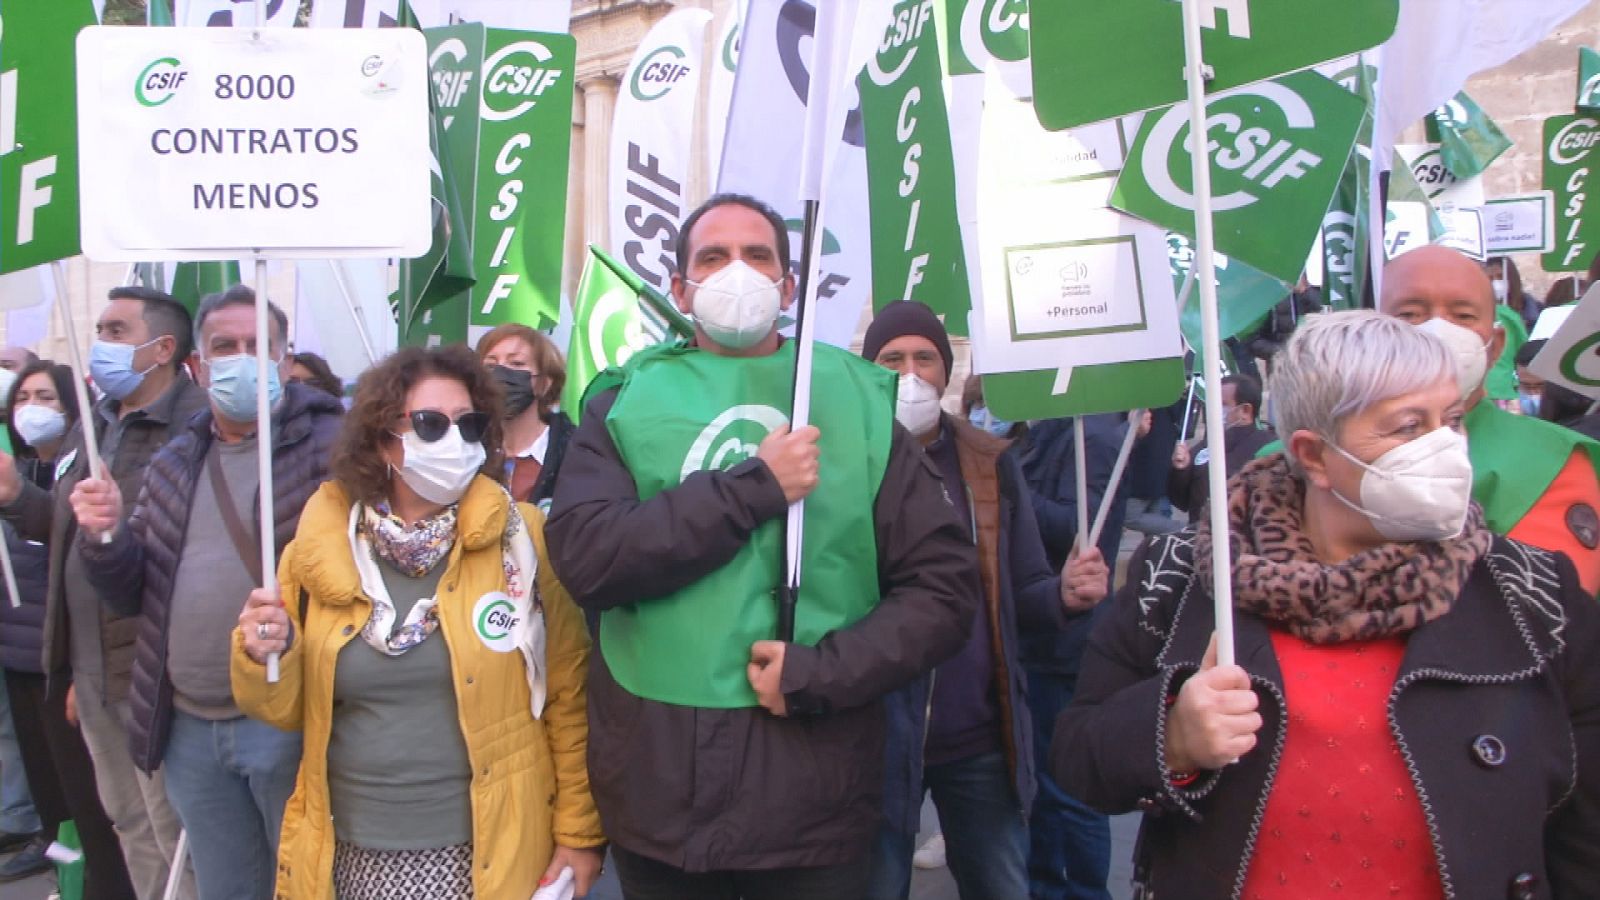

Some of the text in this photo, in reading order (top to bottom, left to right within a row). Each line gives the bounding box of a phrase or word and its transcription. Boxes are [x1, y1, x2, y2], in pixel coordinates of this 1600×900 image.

[146, 71, 189, 91] CSIF
[488, 64, 562, 96] CSIF
[642, 62, 691, 84] CSIF
[215, 74, 296, 100] 8000
[151, 127, 359, 155] CONTRATOS
[1183, 112, 1323, 190] CSIF
[193, 182, 320, 210] MENOS
[480, 133, 532, 315] CSIF
[1046, 301, 1108, 318] +Personal
[488, 610, 520, 630] CSIF
